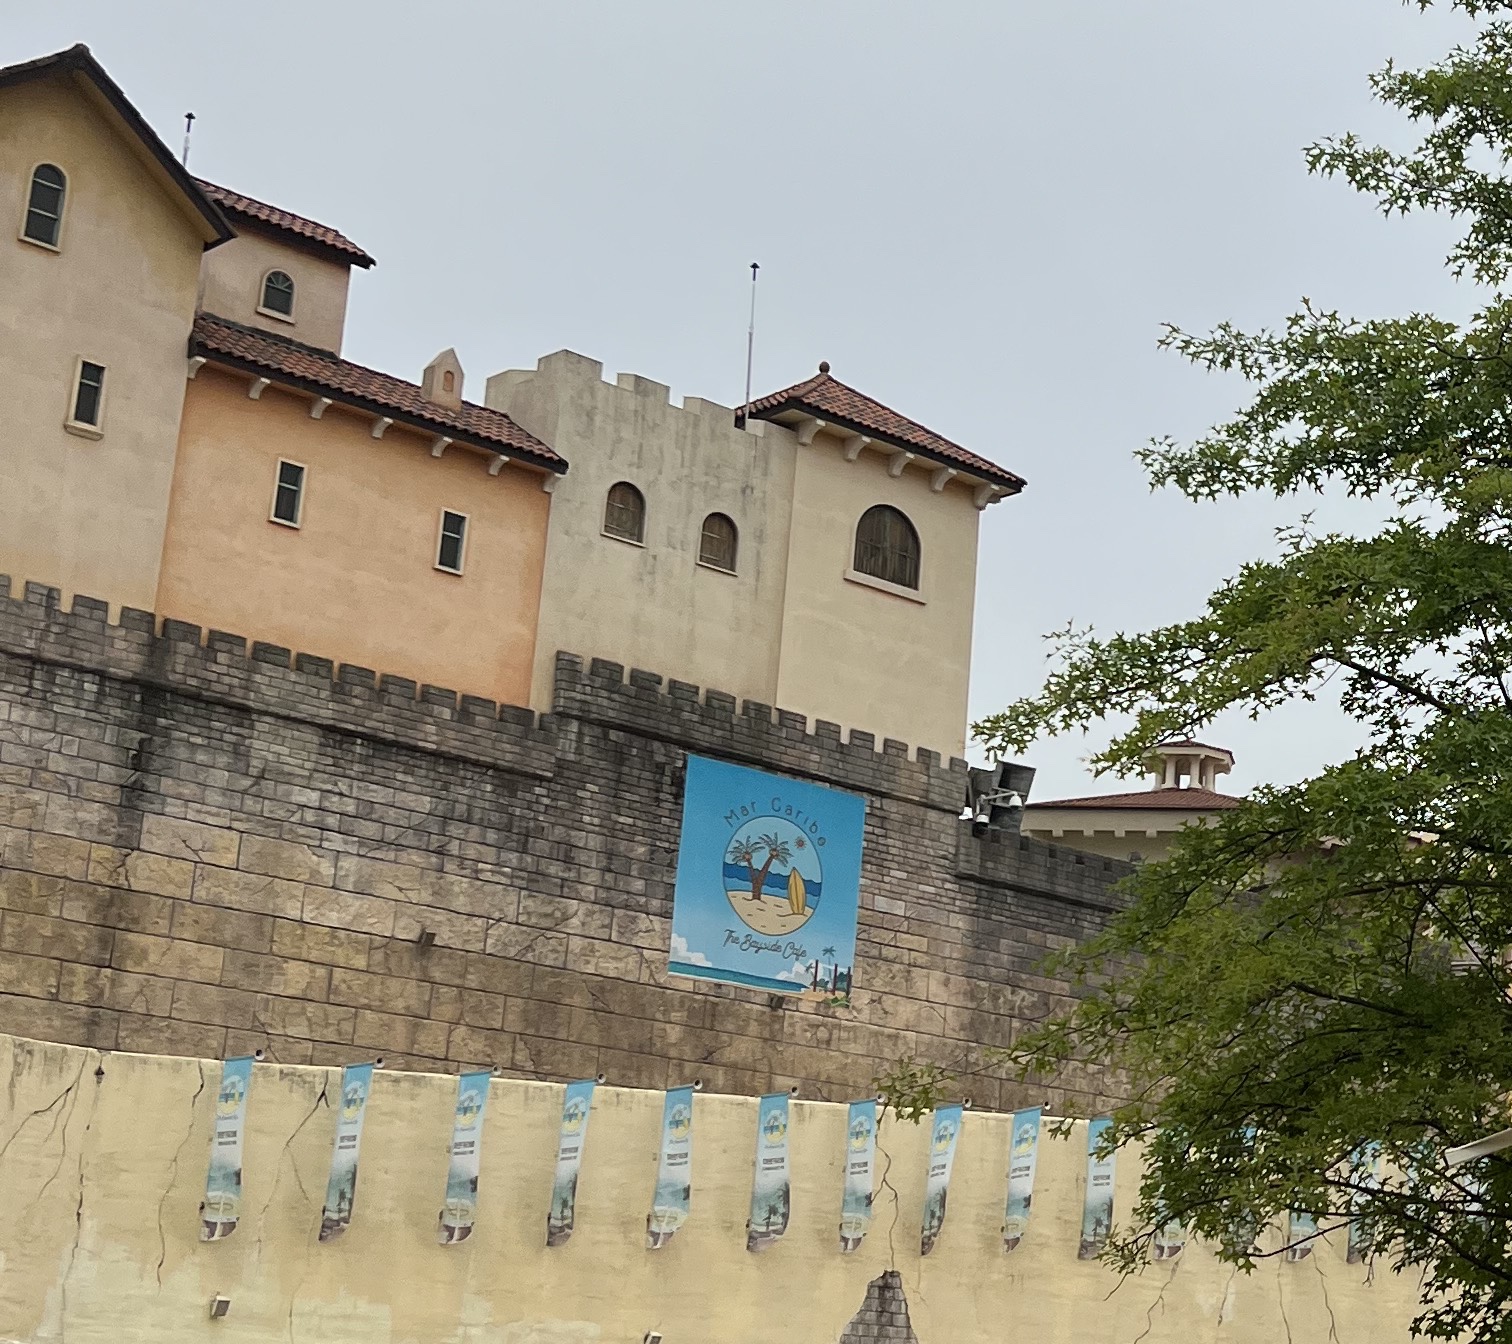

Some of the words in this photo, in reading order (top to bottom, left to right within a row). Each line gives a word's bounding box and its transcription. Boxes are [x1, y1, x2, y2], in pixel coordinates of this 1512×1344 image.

[723, 801, 757, 828] Mar
[771, 797, 826, 846] Caribe
[723, 929, 740, 948] The
[740, 934, 782, 954] Bayside
[782, 941, 807, 961] Cafe
